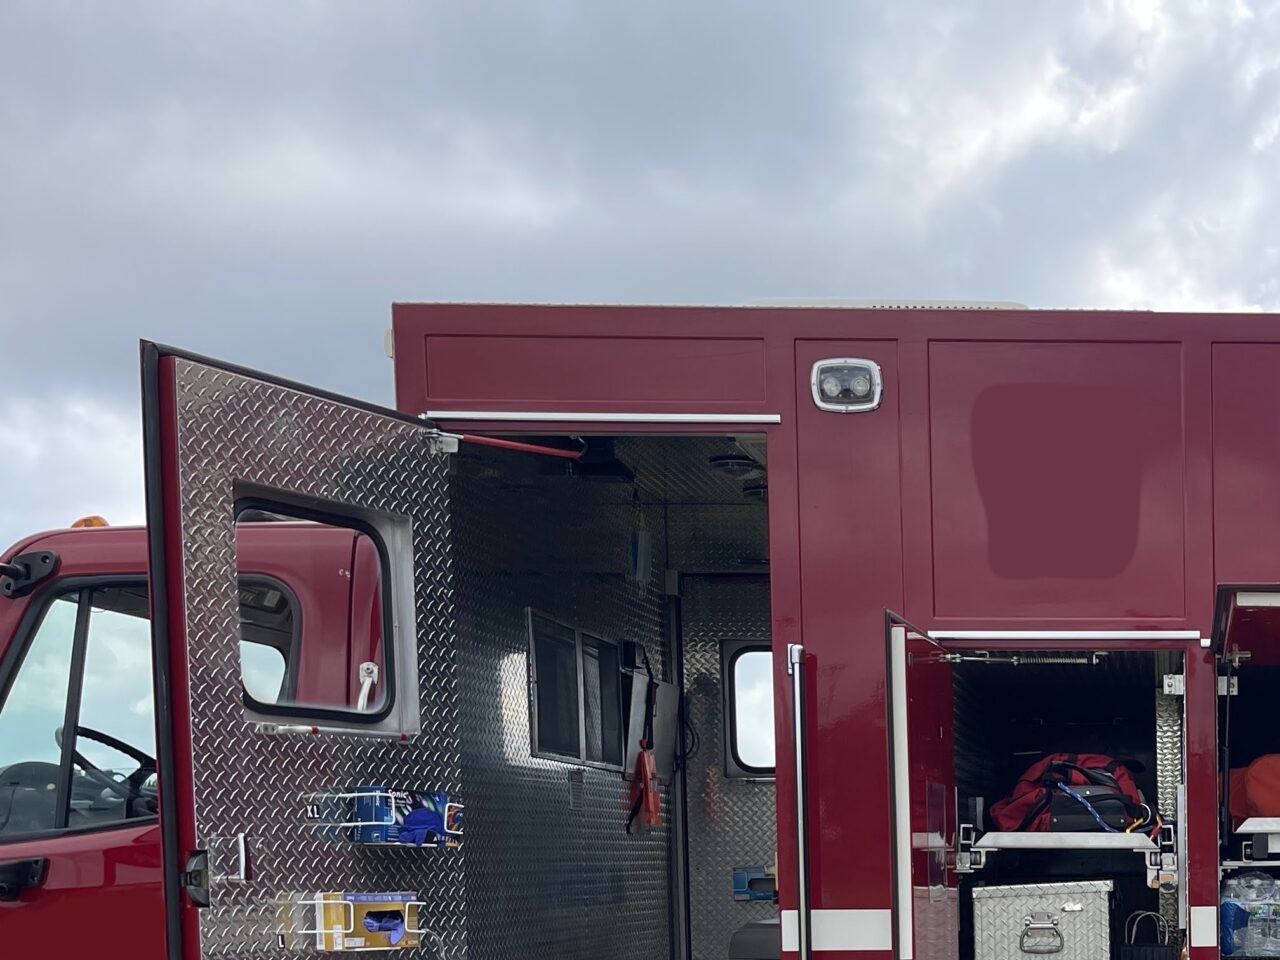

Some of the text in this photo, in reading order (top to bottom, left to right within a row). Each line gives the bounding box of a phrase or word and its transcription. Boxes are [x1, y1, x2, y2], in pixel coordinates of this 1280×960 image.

[387, 788, 408, 799] Sonic
[306, 805, 320, 818] XL
[278, 935, 285, 947] L
